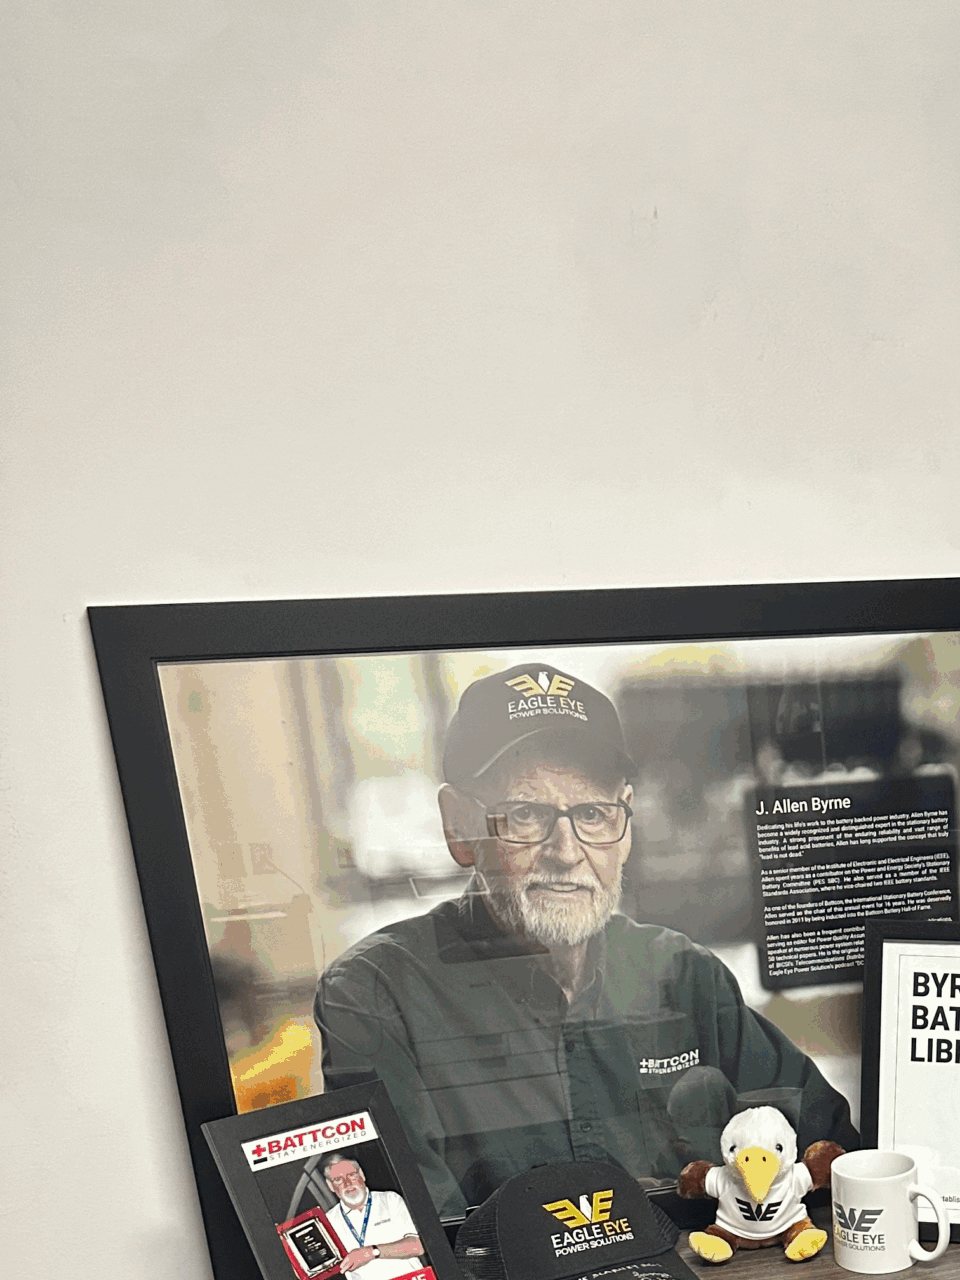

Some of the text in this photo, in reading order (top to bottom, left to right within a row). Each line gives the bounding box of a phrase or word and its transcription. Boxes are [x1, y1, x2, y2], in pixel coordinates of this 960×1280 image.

[508, 696, 586, 714] EAGLE EYE
[509, 707, 588, 722] POWER SOLUTIONS
[755, 796, 851, 816] J. Allen Byrne
[267, 1117, 366, 1155] BATTCON
[269, 1130, 367, 1162] STAY ENERGIZED
[551, 1217, 632, 1249] EAGLE EYE
[862, 1233, 885, 1245] EYE
[555, 1231, 635, 1258] POWER SOLUTIONS
[849, 1243, 886, 1252] SOLUTIONS
